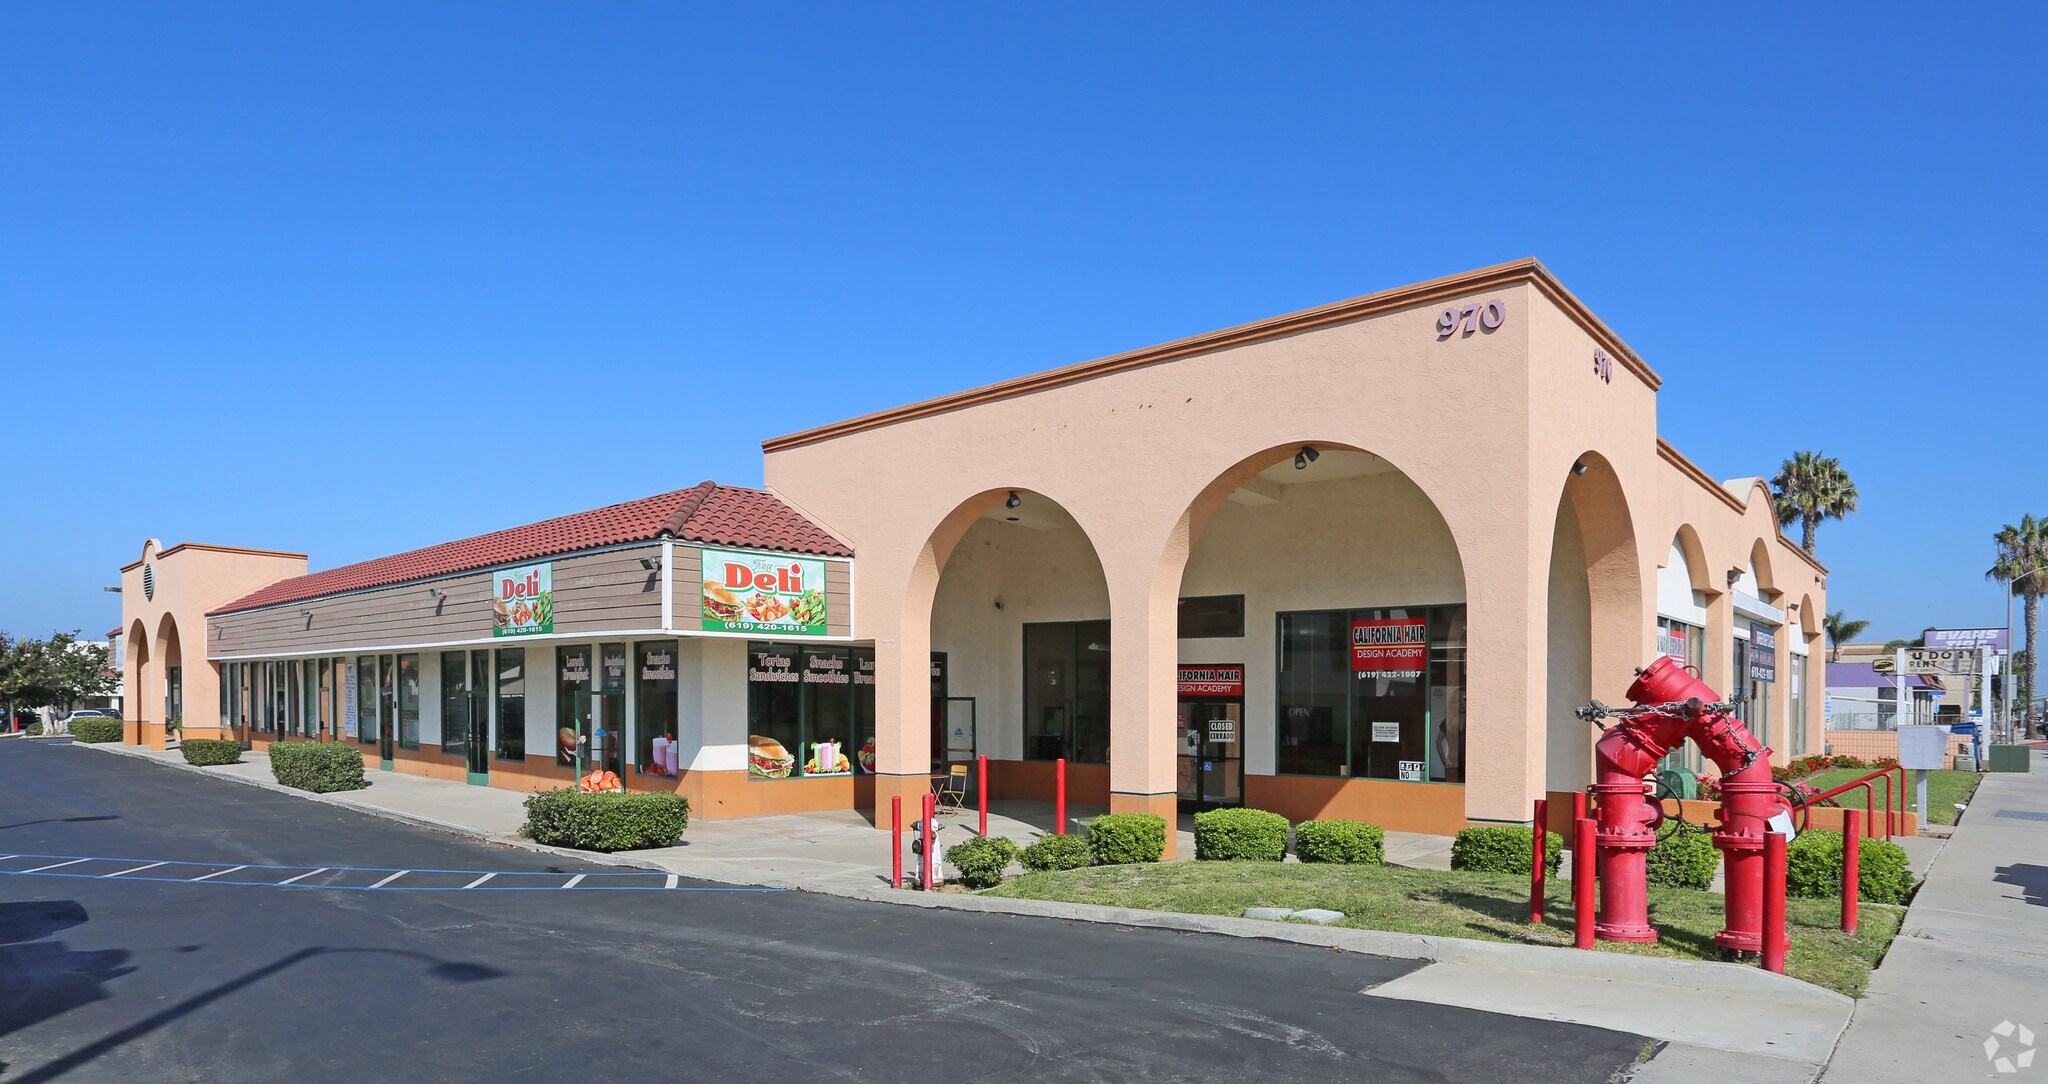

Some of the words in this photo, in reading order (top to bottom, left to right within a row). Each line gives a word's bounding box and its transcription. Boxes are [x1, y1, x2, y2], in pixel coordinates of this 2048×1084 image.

[1438, 299, 1507, 336] 970
[1594, 348, 1613, 385] 970
[723, 563, 803, 593] Deli
[501, 569, 539, 600] Deli
[502, 627, 516, 636] (619)
[517, 626, 543, 634] 420-1615
[724, 621, 754, 630] (619)
[757, 623, 808, 632] 420-1615
[1353, 625, 1402, 645] CALIFORNIA
[1403, 624, 1426, 643] HAIR
[1935, 629, 1999, 640] EVANS
[646, 649, 671, 665] Snacks
[1357, 649, 1384, 658] DESIGN
[1385, 649, 1423, 658] ACADEMY
[1913, 651, 1922, 660] U
[758, 653, 791, 667] Tortas
[809, 655, 843, 669] Snacks
[1909, 660, 1937, 668] RENT
[642, 665, 676, 680] Smoothies
[750, 668, 799, 682] Sandwiches
[803, 670, 850, 684] Smoothies
[1217, 670, 1241, 681] HAIR
[1358, 671, 1379, 679] (619)
[1289, 707, 1309, 717] OPEN
[1210, 722, 1234, 731] CLOSED
[1209, 731, 1235, 740] CERRADO
